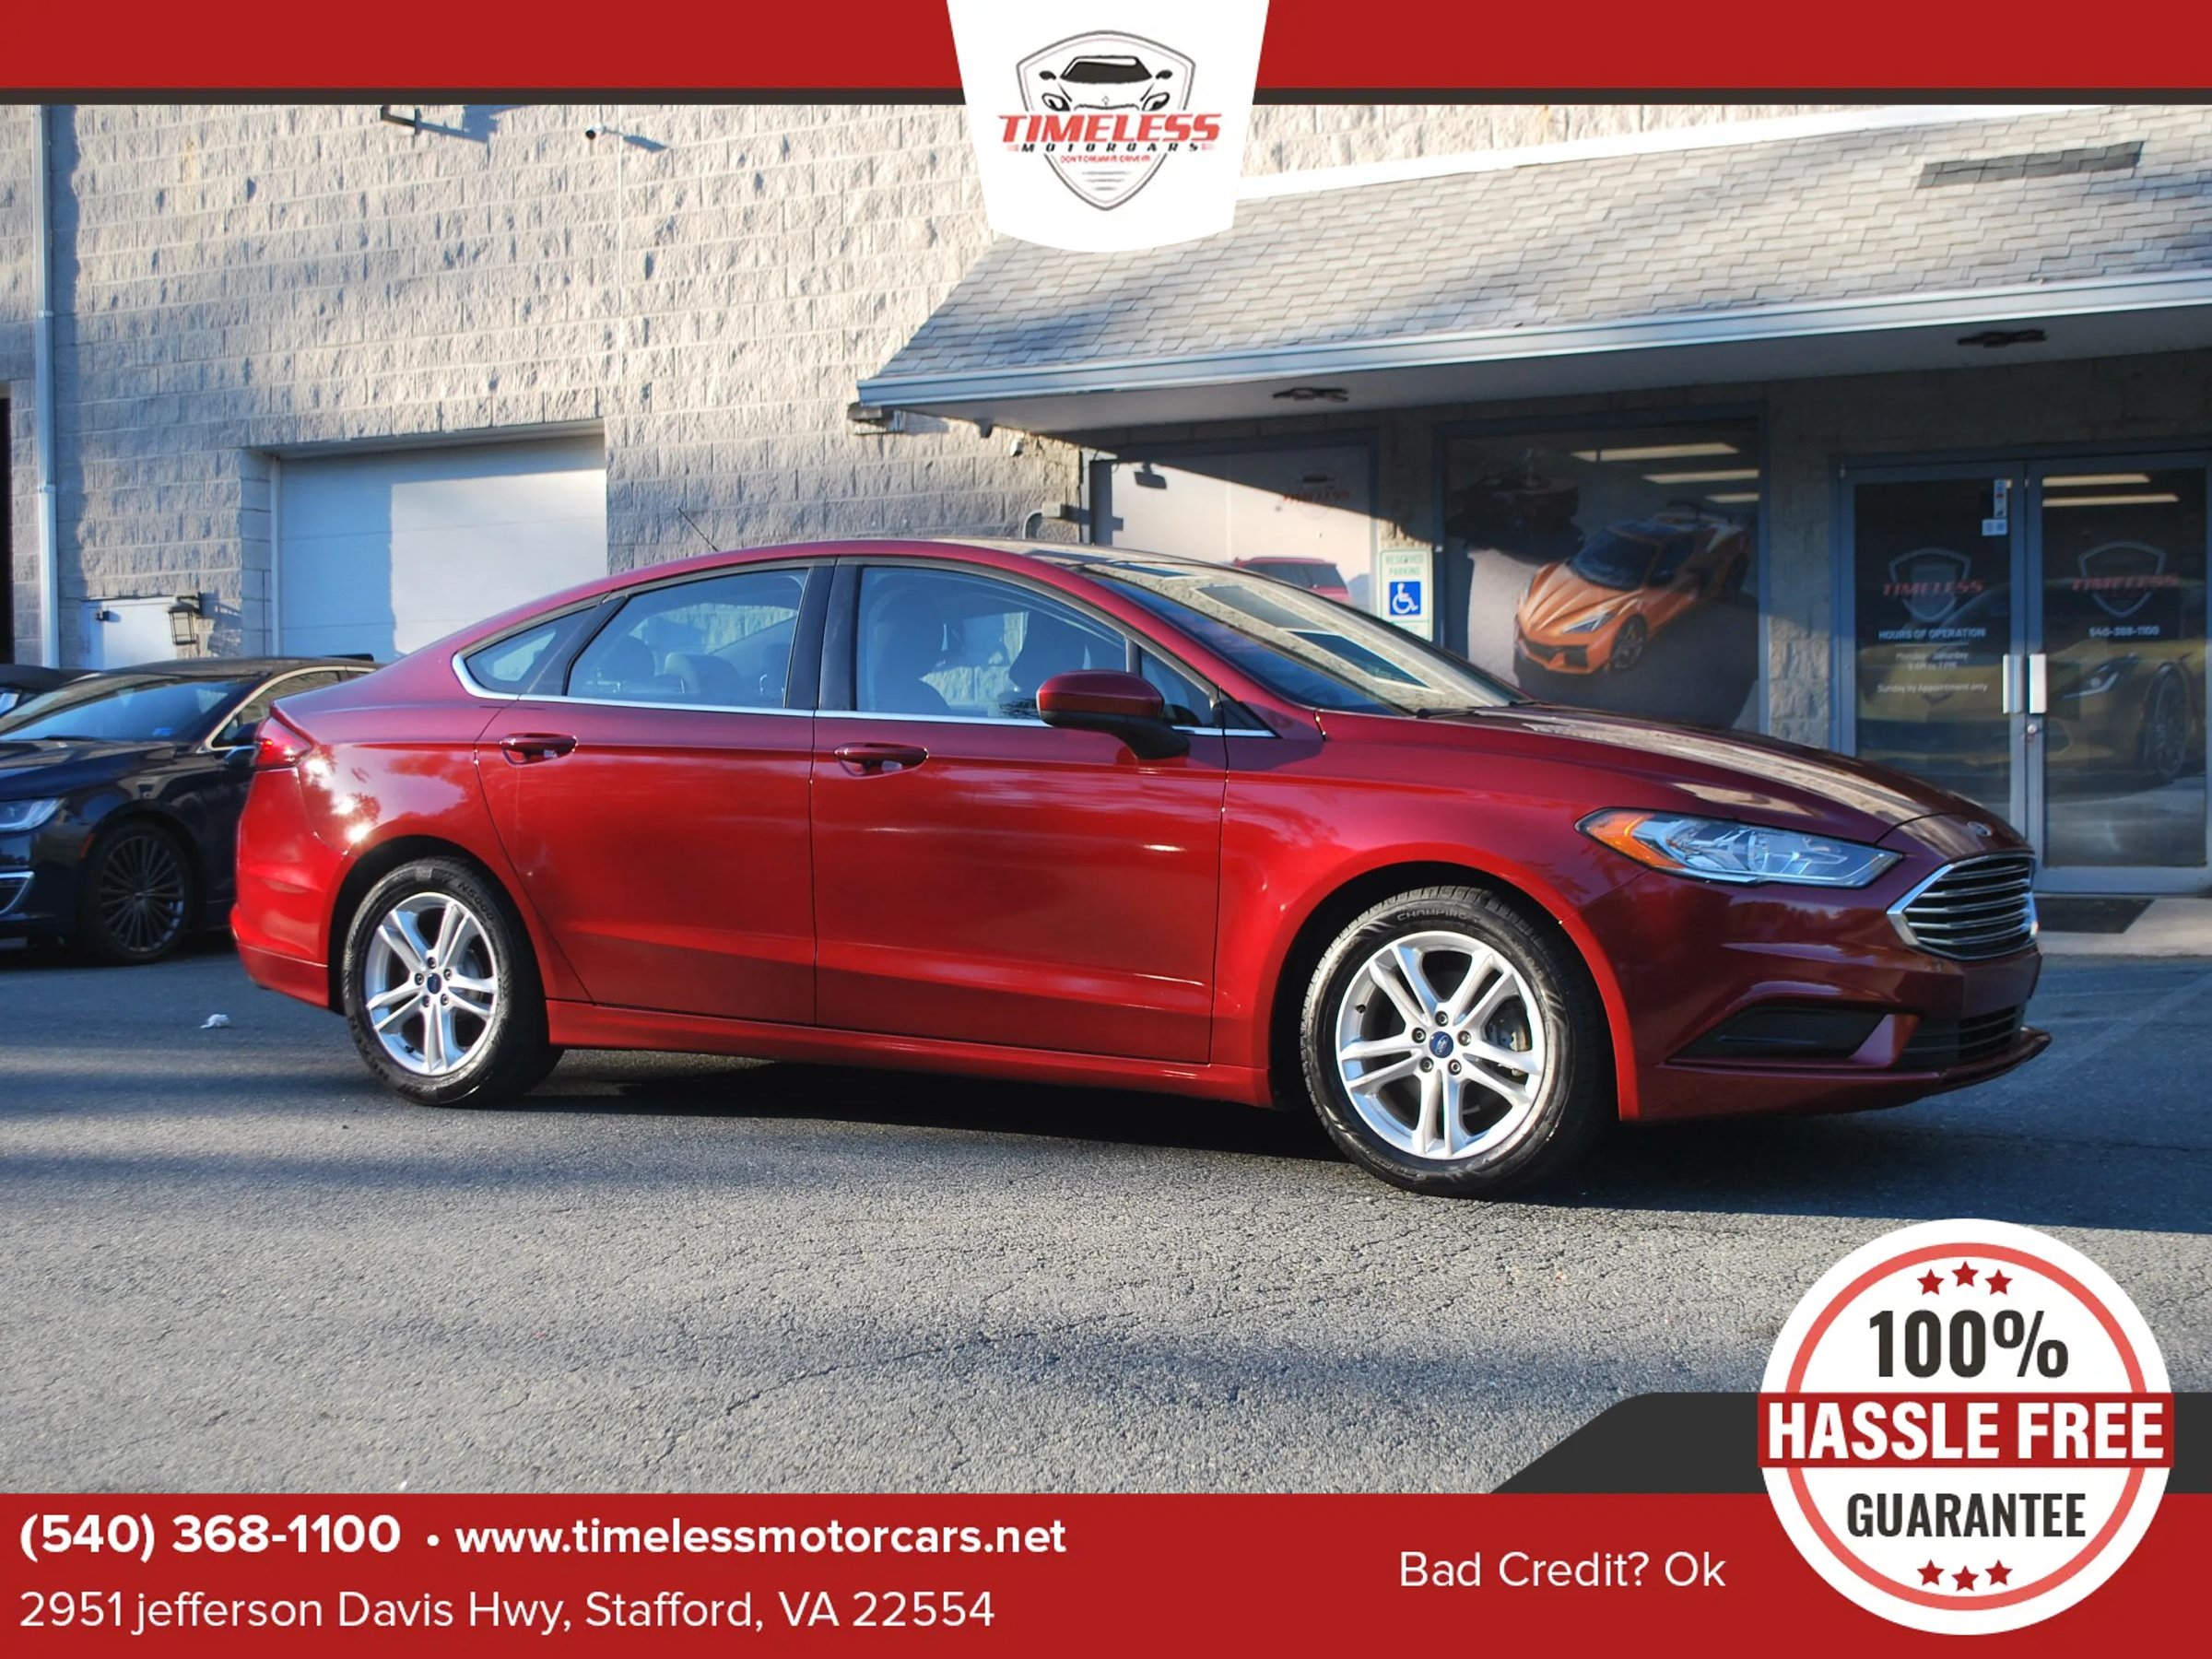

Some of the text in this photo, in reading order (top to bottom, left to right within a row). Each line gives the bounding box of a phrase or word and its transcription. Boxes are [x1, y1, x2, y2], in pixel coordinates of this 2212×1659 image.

[1389, 567, 1420, 576] PARKING
[1883, 581, 1984, 595] TIMELESS
[1878, 628, 1986, 640] HOURS OF OPERATION
[1877, 684, 1905, 694] Sunday
[1918, 683, 1970, 693] Appointment
[1971, 683, 1988, 692] only
